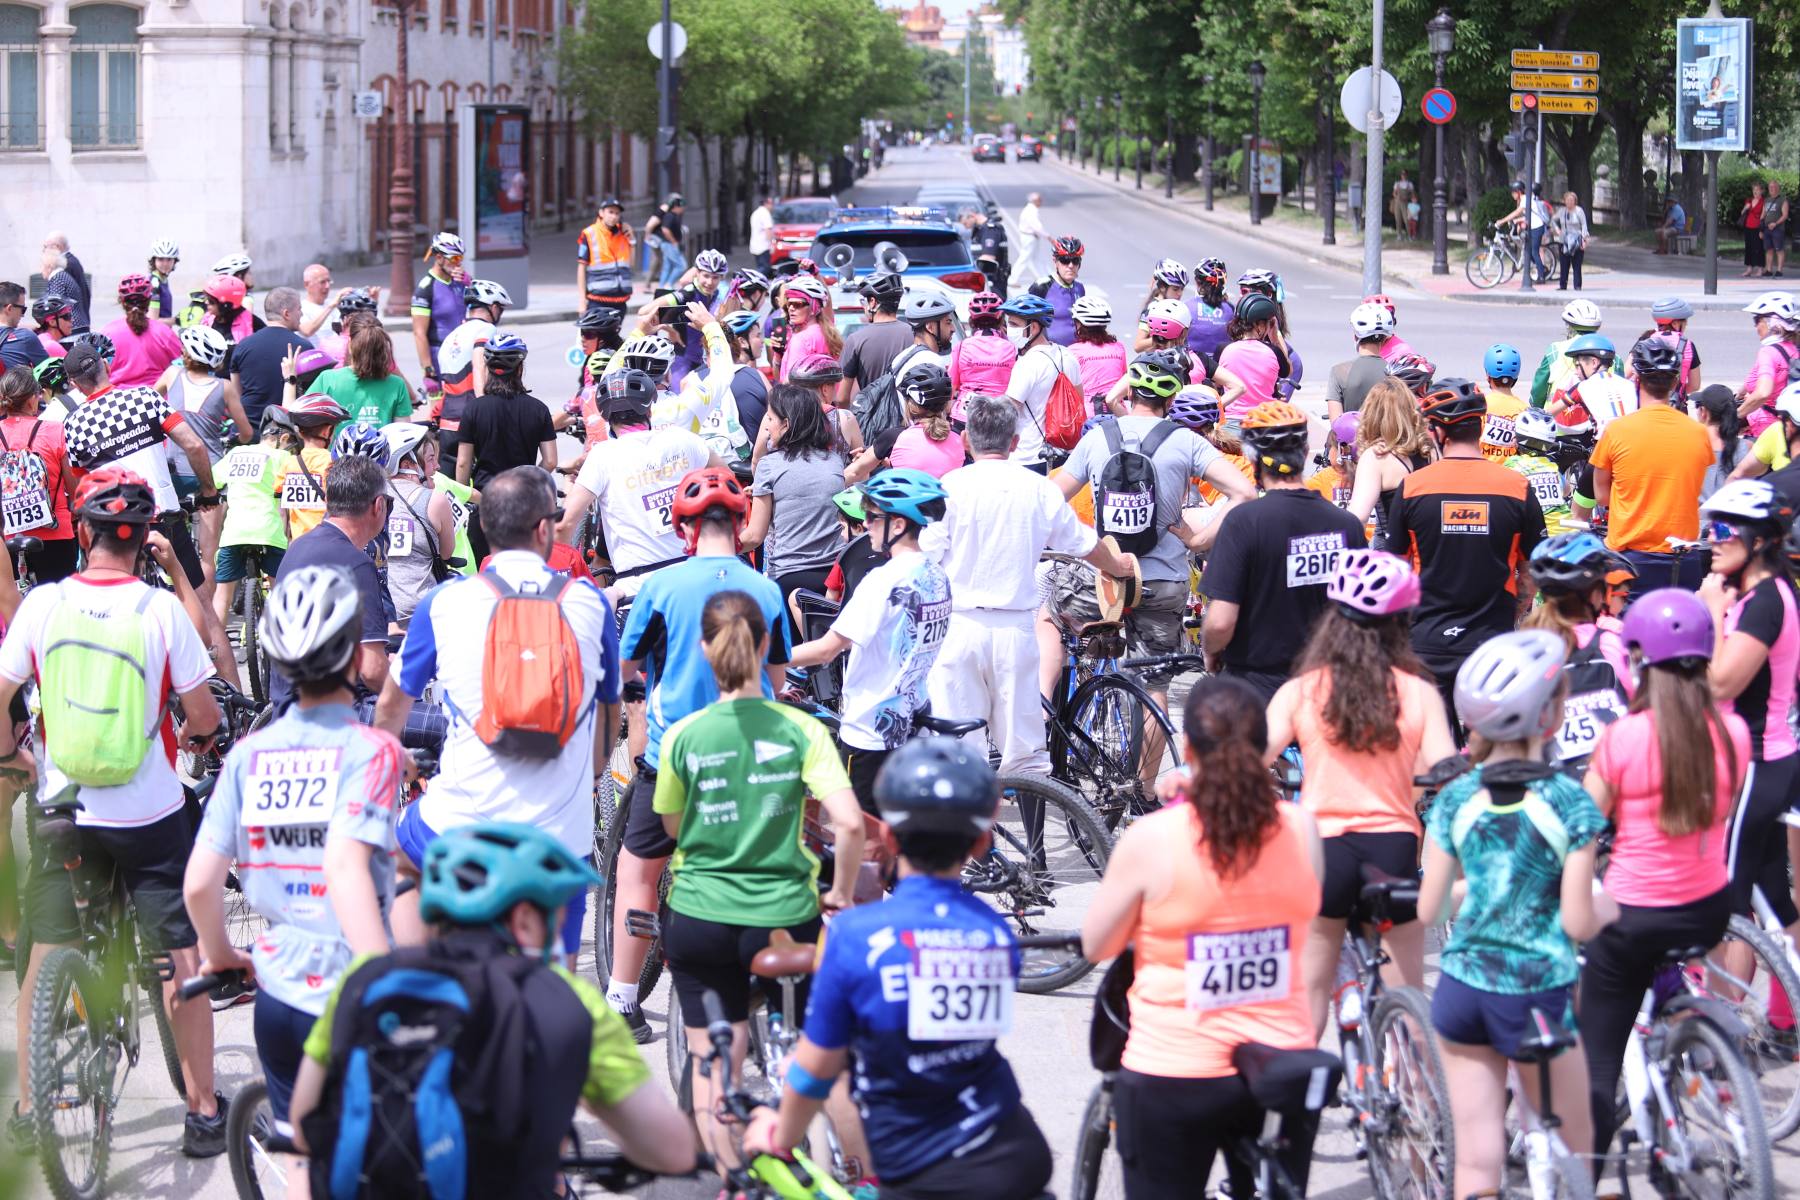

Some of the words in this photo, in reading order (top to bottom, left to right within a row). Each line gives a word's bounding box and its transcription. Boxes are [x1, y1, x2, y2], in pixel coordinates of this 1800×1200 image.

[1541, 100, 1573, 108] hoteles
[358, 406, 379, 415] ATF
[100, 424, 151, 450] estropeados
[1487, 427, 1513, 442] 470
[115, 442, 139, 456] cycling
[138, 436, 154, 446] team
[229, 463, 260, 477] 2618
[286, 487, 319, 502] 2617
[647, 487, 678, 502] DIPUTAC
[1538, 484, 1559, 499] 518
[1108, 498, 1151, 507] BURGOS
[6, 504, 44, 527] 1733
[659, 507, 672, 526] 2
[1112, 507, 1148, 527] 4113
[1450, 509, 1481, 519] KTM
[393, 533, 405, 549] 3
[1291, 540, 1343, 554] BURGOS
[923, 617, 948, 644] 2178
[256, 777, 327, 810] 3372
[270, 827, 328, 848] WÜR
[1201, 957, 1278, 995] 4169
[930, 984, 1001, 1021] 3371
